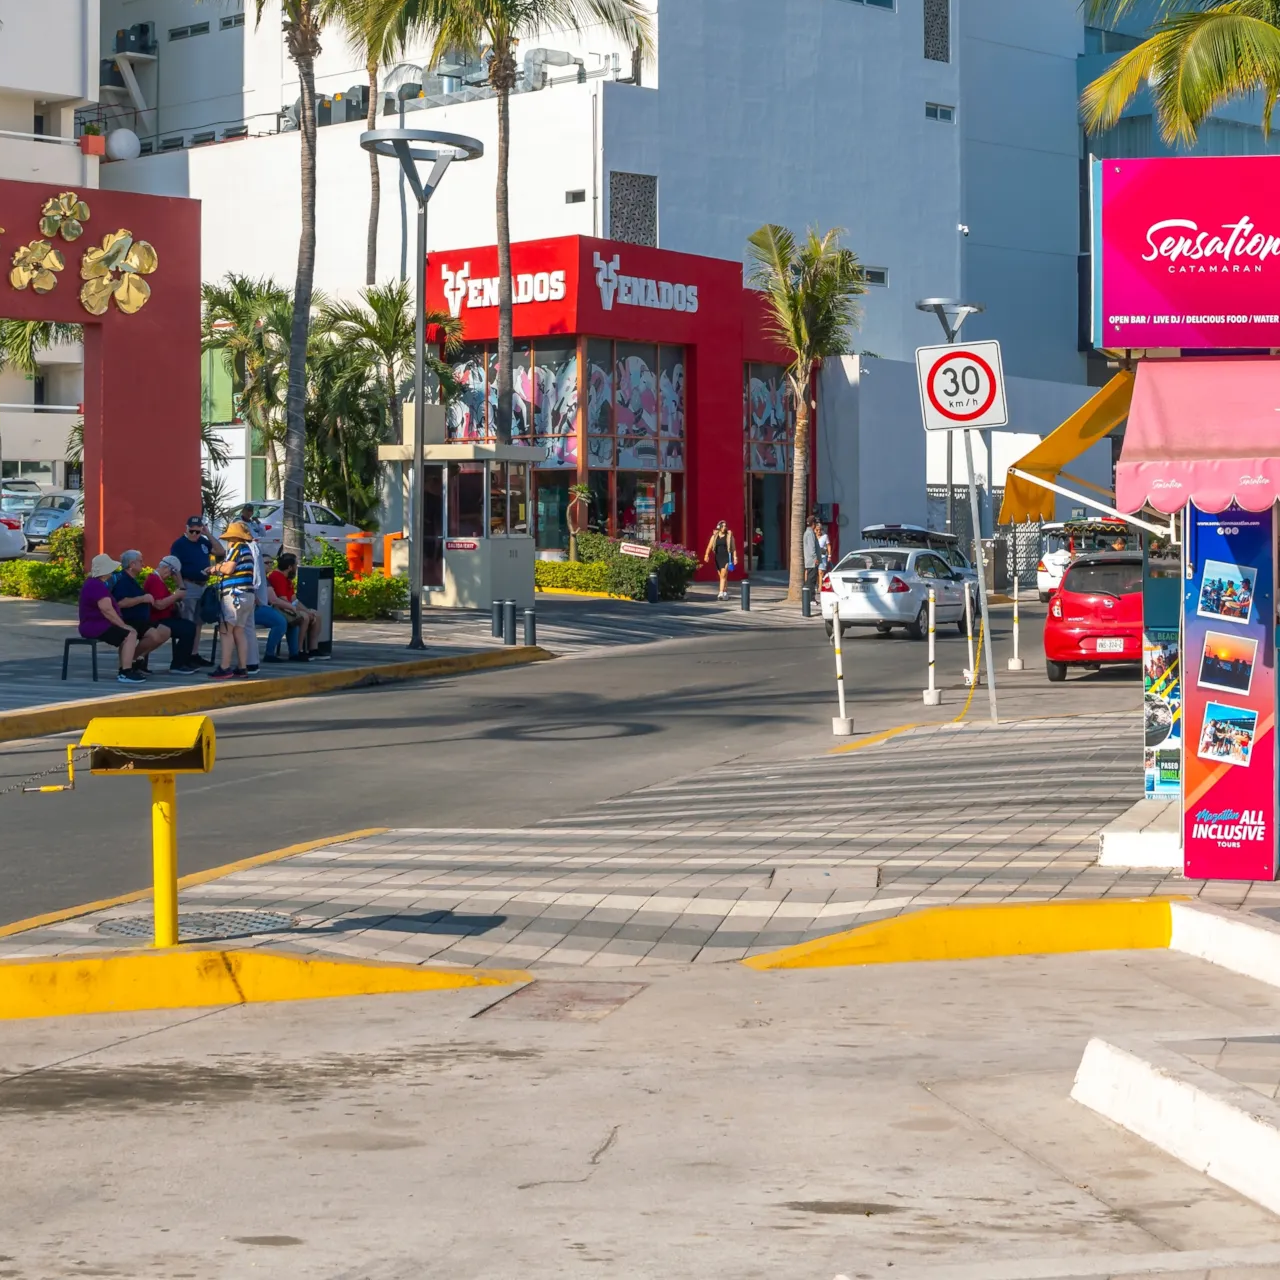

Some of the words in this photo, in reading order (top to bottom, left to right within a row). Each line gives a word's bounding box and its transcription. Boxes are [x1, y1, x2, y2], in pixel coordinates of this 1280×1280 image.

[1168, 264, 1263, 274] CATAMARAN
[1109, 316, 1129, 324] OPEN
[1130, 316, 1146, 324] BAR
[1153, 315, 1170, 324] LIVE
[1171, 315, 1180, 324] DJ
[1186, 315, 1225, 324] DELICIOUS
[1227, 315, 1248, 323] FOOD
[1254, 314, 1279, 323] WATER
[942, 364, 980, 397] 30
[948, 397, 978, 409] km/h
[1160, 762, 1179, 770] PASEO
[1239, 810, 1265, 825] ALL
[1191, 823, 1266, 841] INCLUSIVE
